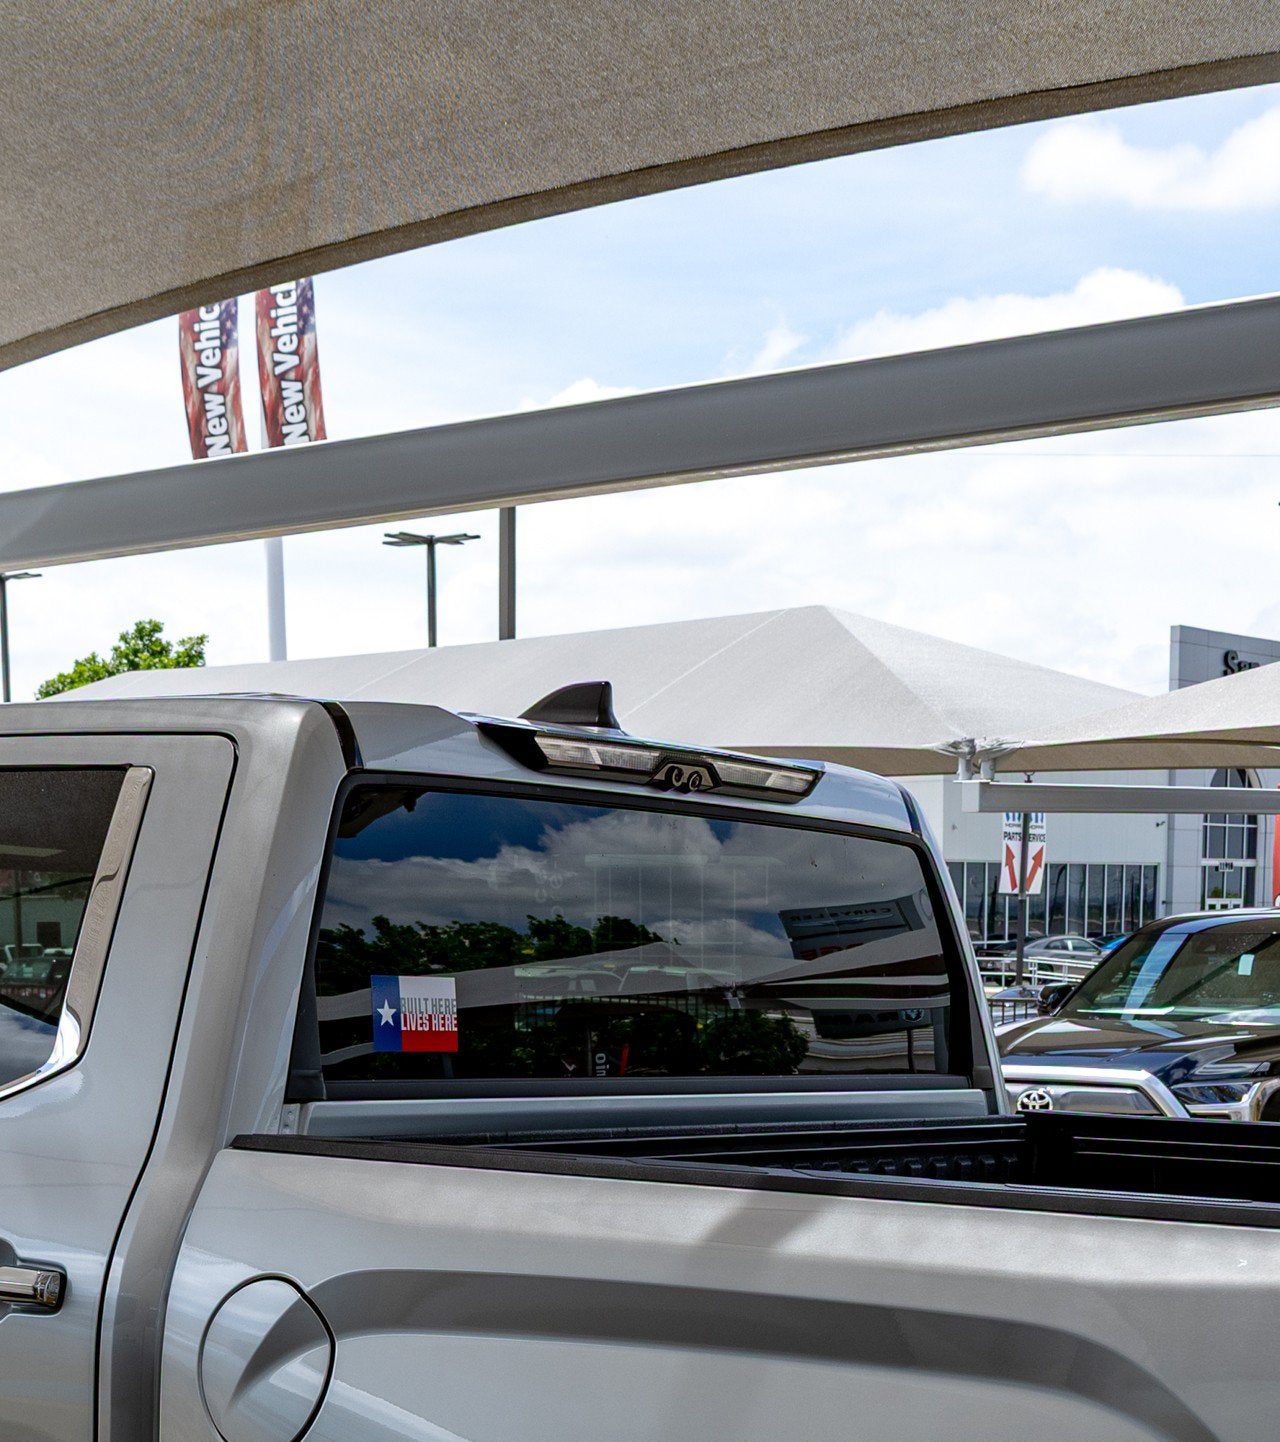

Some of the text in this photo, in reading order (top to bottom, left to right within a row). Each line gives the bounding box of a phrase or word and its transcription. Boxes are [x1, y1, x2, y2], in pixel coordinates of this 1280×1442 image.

[193, 303, 233, 458] New Vehic
[280, 379, 311, 446] New
[1028, 833, 1046, 843] ERVICE
[400, 997, 457, 1015] BUILT HERE
[401, 1013, 458, 1031] LIVES HERE
